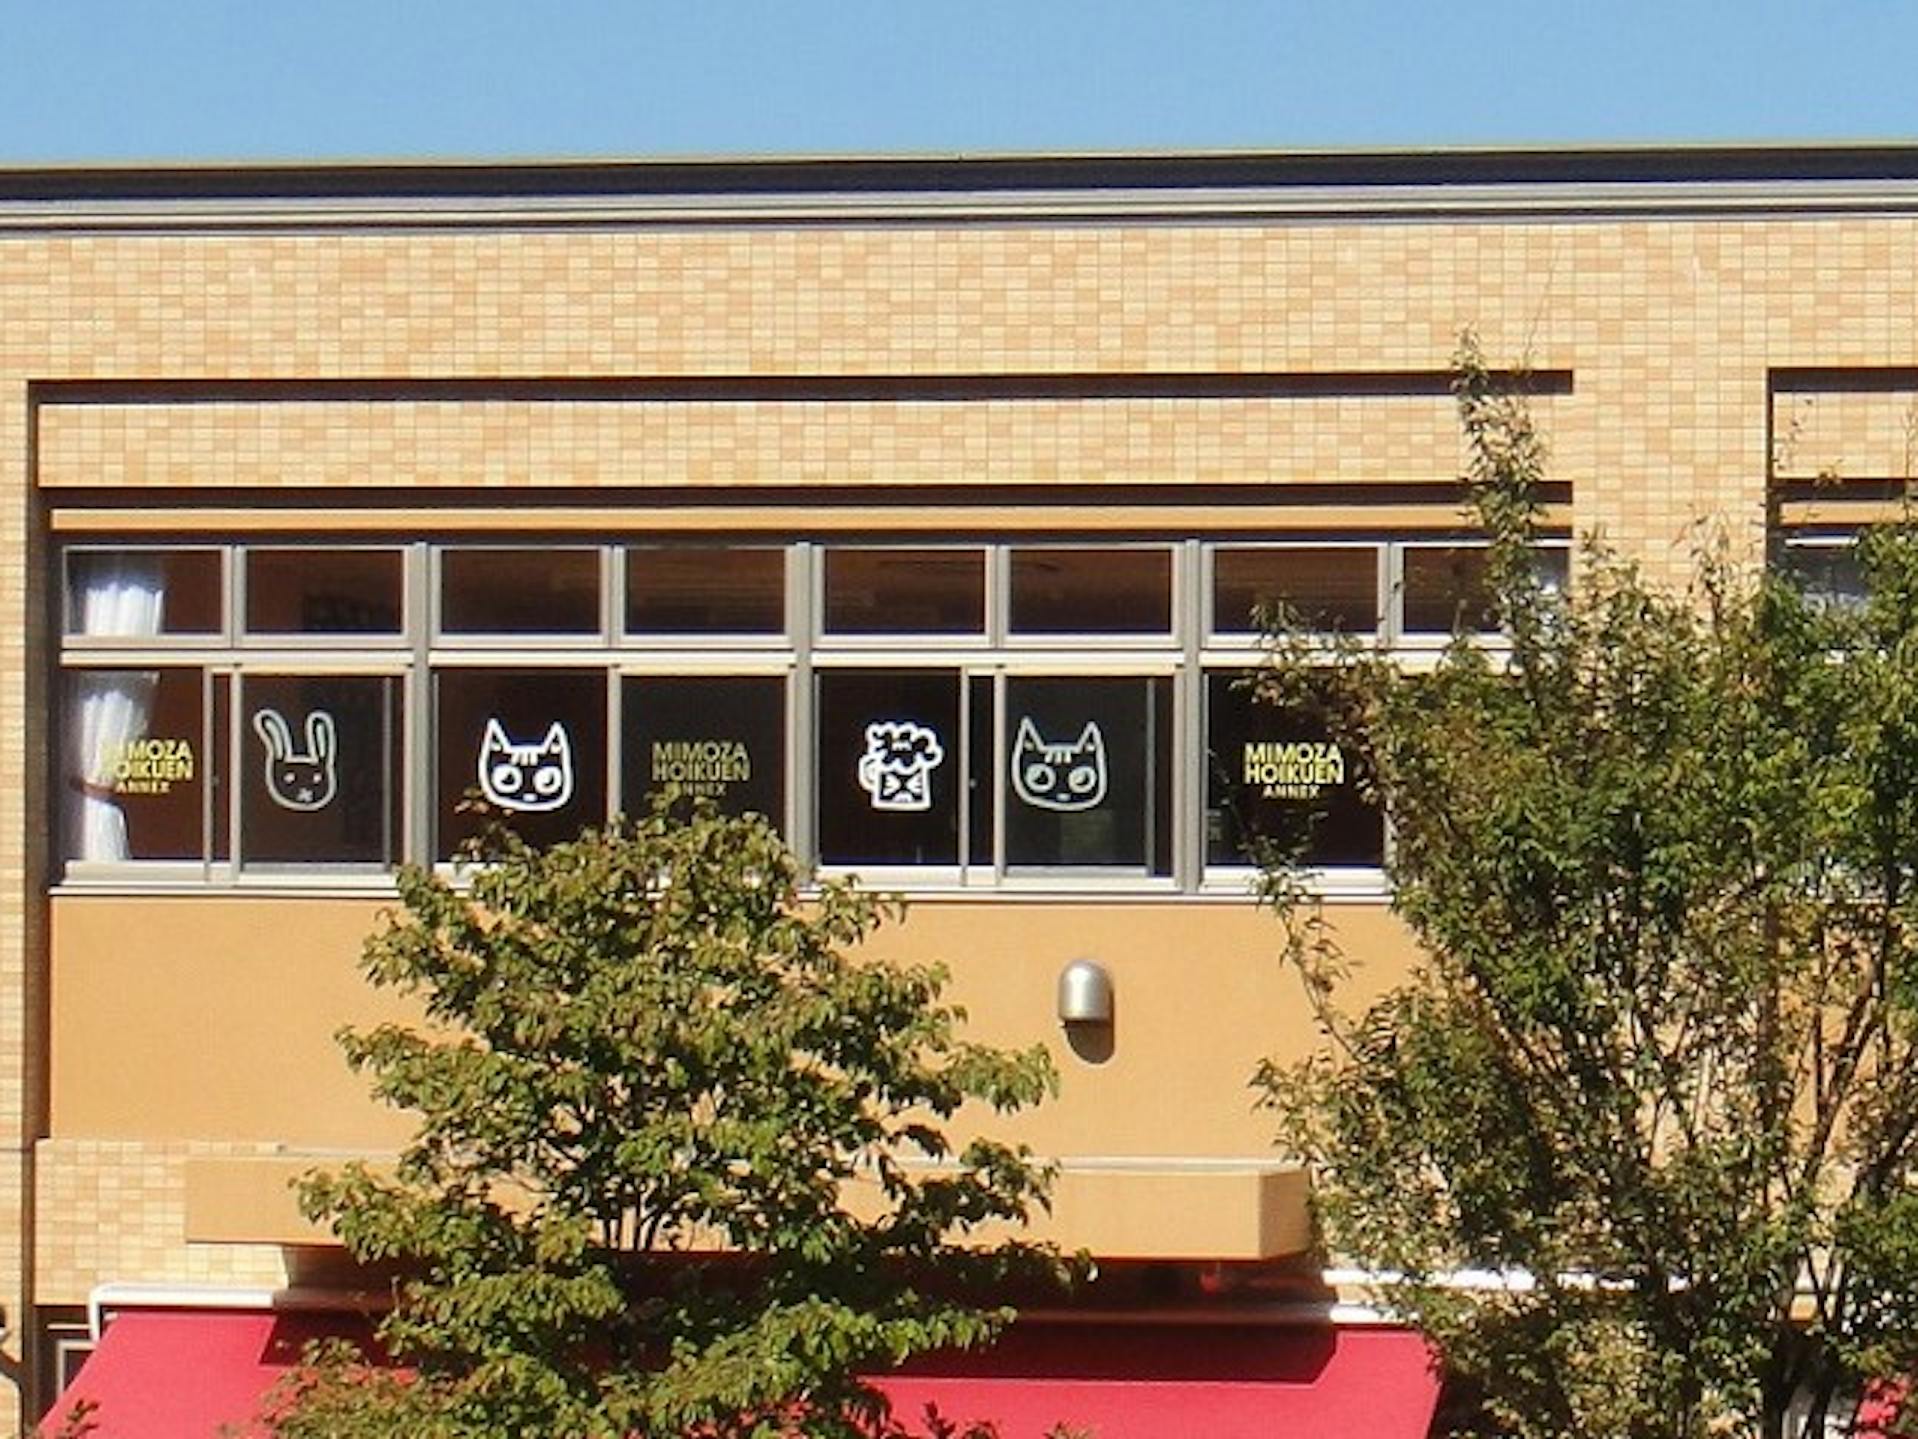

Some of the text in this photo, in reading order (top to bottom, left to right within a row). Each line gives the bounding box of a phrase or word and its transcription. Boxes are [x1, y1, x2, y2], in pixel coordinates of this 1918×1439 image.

[652, 741, 748, 761] MIMOZA
[1244, 742, 1342, 763] MIMOZA
[652, 760, 751, 781] HOIKUEN
[1244, 762, 1345, 785] HOIKUEN
[1263, 784, 1320, 799] ANNEX
